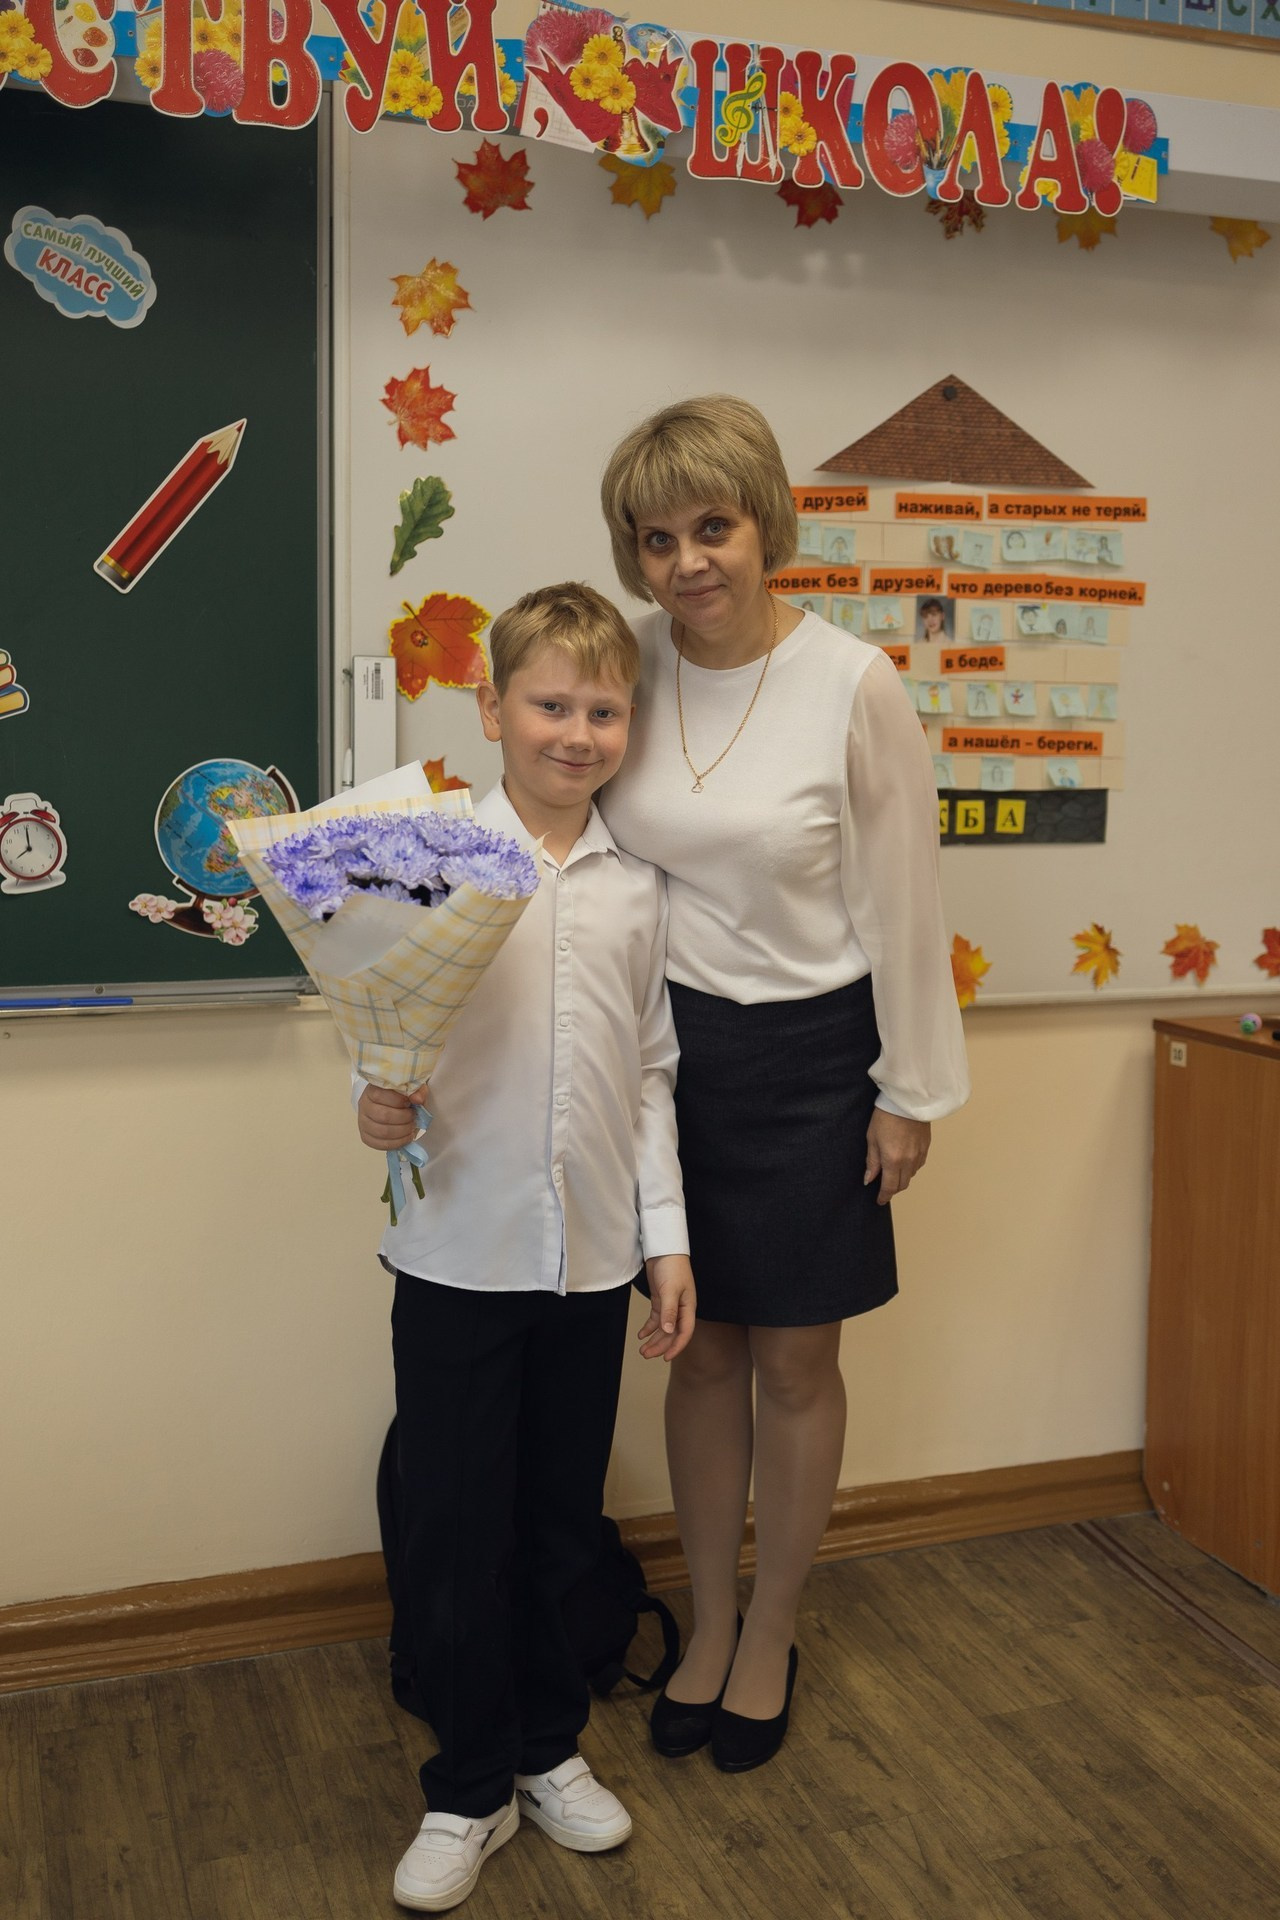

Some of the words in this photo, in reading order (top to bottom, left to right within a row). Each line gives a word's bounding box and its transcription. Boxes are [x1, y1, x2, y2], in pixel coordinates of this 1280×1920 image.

[688, 38, 1127, 217] ШКОЛА!
[23, 222, 84, 251] САМЫЙ
[84, 246, 146, 299] ЛУЧШИЙ
[38, 247, 113, 303] КЛАСС
[802, 492, 867, 511] друзей
[898, 502, 980, 519] наживай,
[989, 503, 999, 514] а
[1004, 504, 1067, 518] старых
[1072, 506, 1091, 517] не
[1095, 503, 1146, 519] теряй.
[764, 576, 821, 590] ловек
[826, 573, 859, 588] без
[872, 575, 941, 593] друзей,
[950, 583, 978, 593] что
[983, 582, 1043, 597] дерево
[1044, 581, 1074, 597] без
[1079, 586, 1143, 601] корней.
[945, 658, 954, 669] в
[958, 653, 1003, 669] беде.
[948, 737, 958, 747] а
[963, 736, 1021, 749] нашёл
[1037, 735, 1098, 753] береги.
